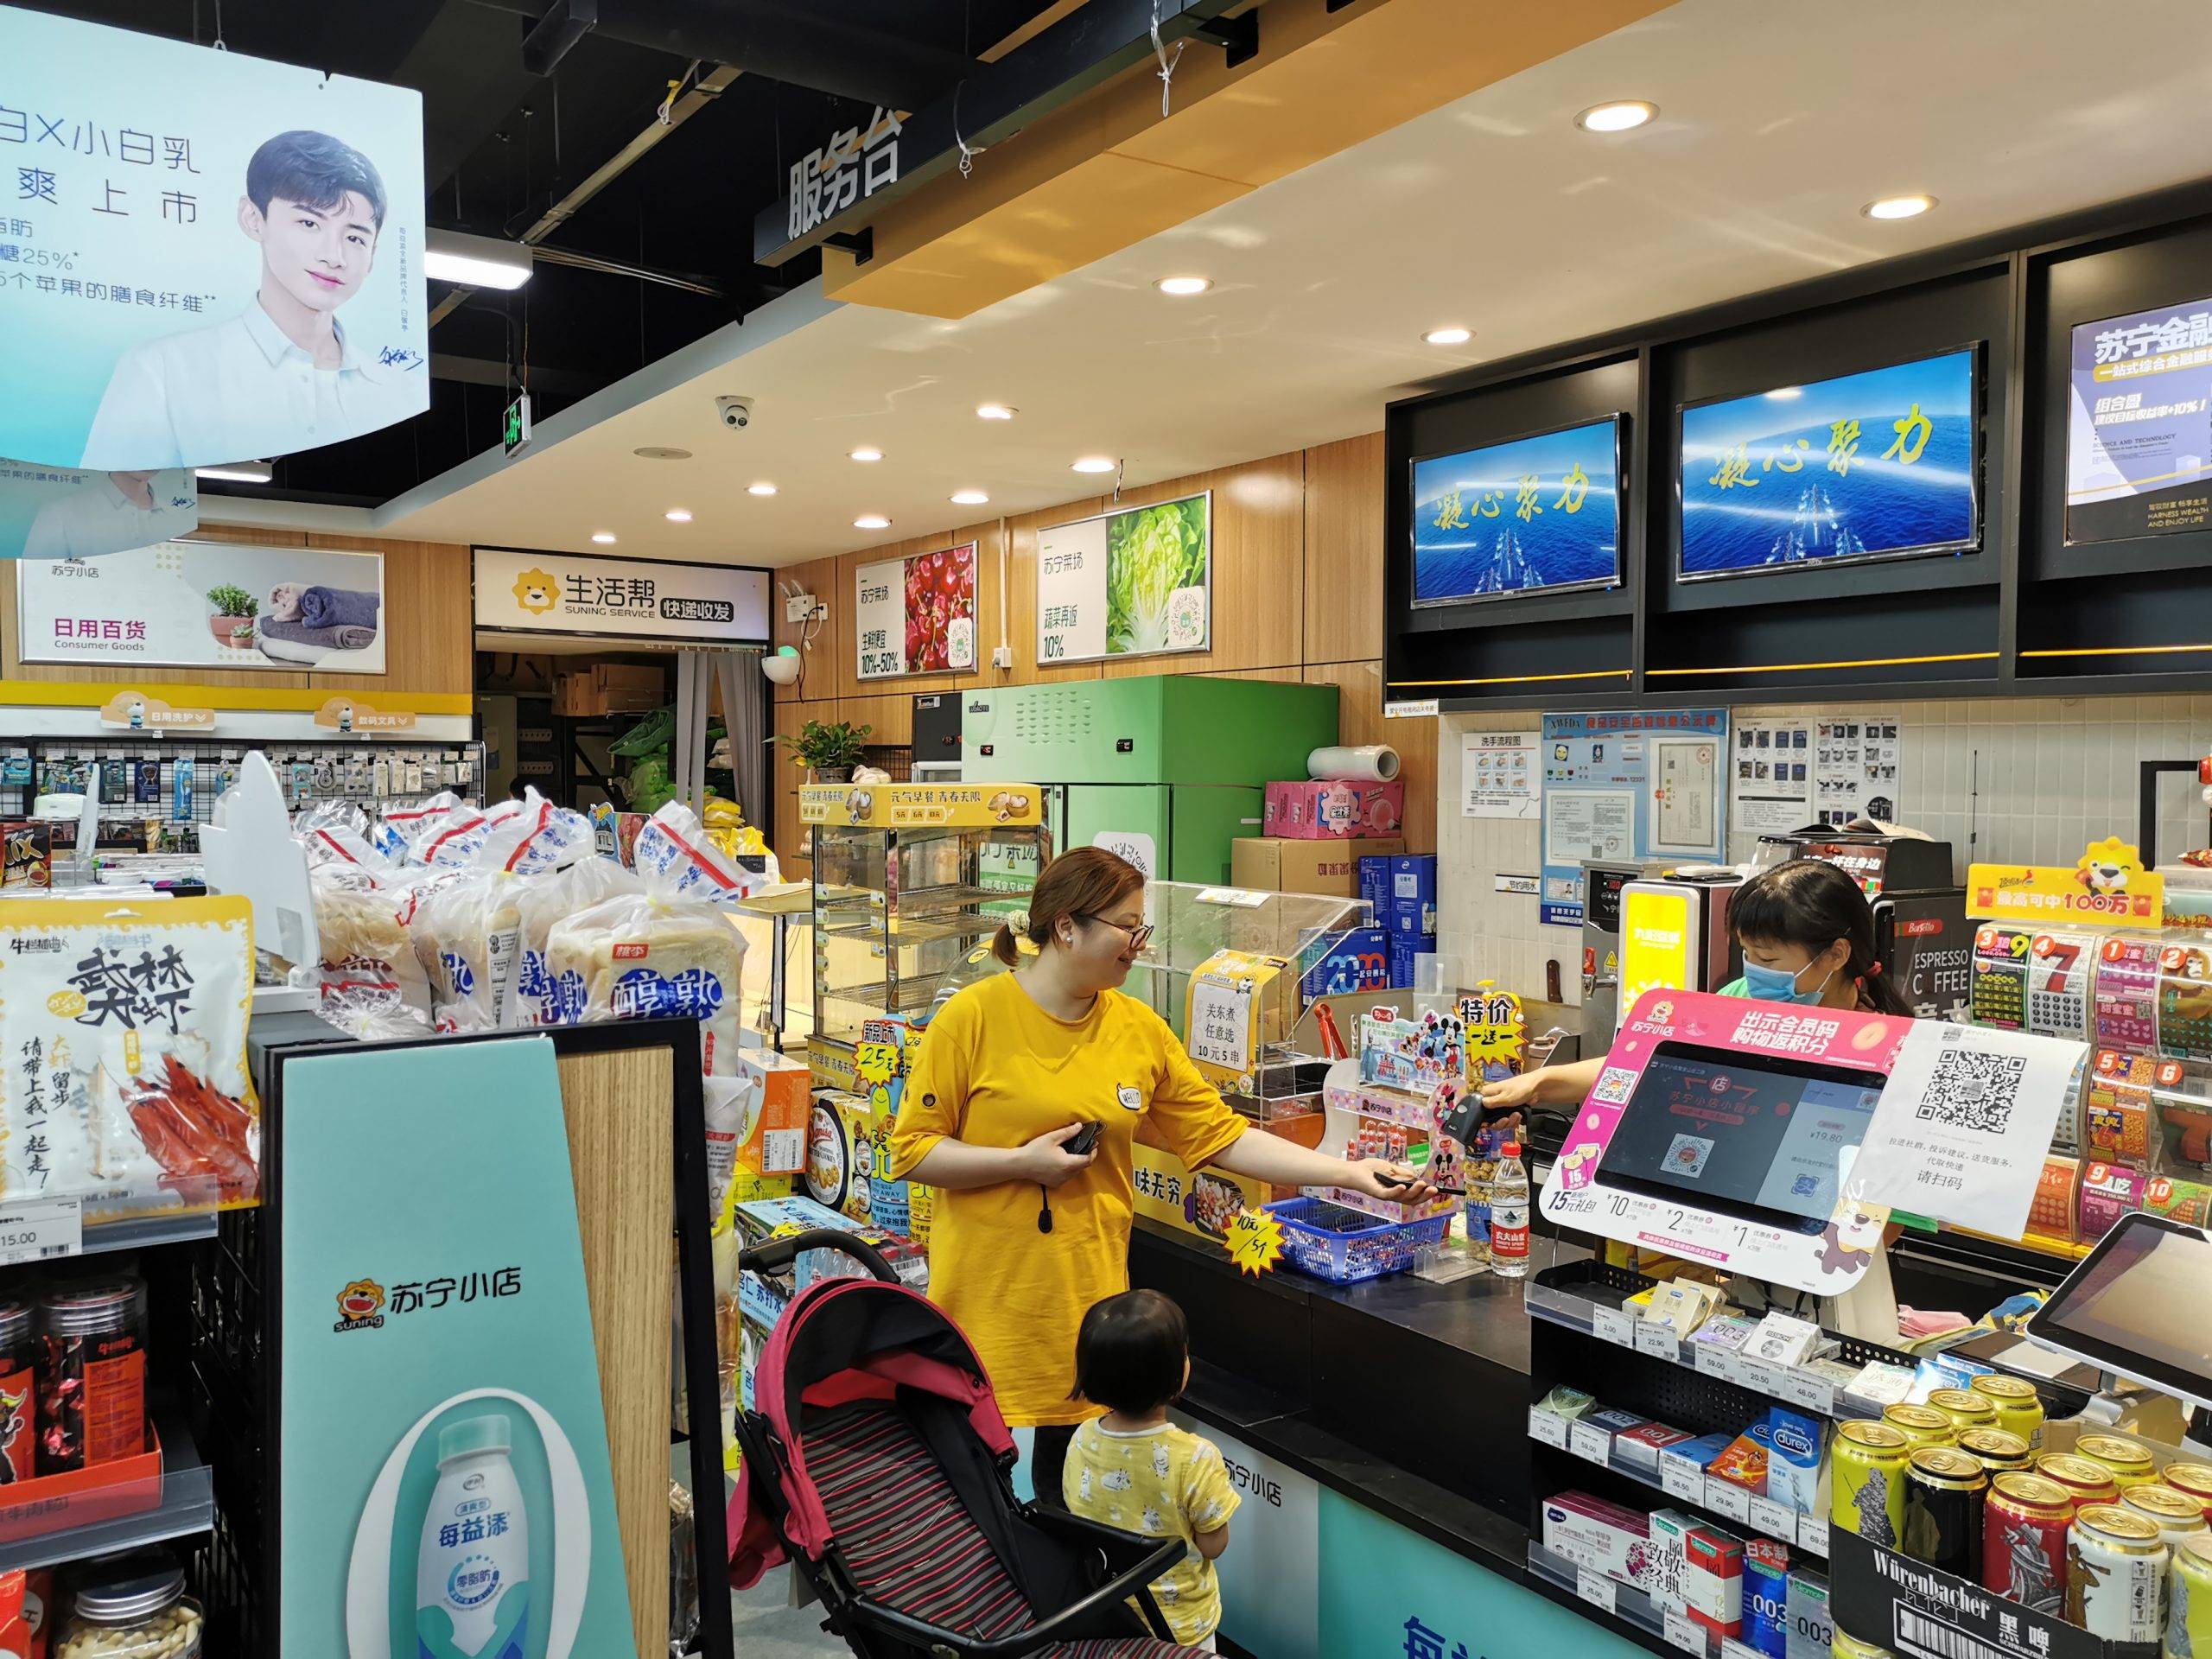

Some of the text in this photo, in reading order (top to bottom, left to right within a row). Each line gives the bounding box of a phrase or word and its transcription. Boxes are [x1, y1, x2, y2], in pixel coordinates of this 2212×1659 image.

[788, 105, 903, 240] 服务台
[1709, 403, 1933, 490] 凝心聚力
[1433, 462, 1590, 531] 凝心聚力
[52, 565, 99, 578] 苏宁小店
[1044, 552, 1084, 575] 苏宁菜场
[565, 575, 655, 608] 生活帮
[861, 586, 889, 605] 苏宁菜场
[565, 606, 655, 619] SUNING SERVICE
[663, 600, 732, 621] 快递收发
[54, 618, 146, 640] 日用百货
[54, 640, 144, 652] Consumer Goods
[1044, 634, 1064, 658] 10%
[862, 652, 898, 675] 10%-50%
[1481, 736, 1521, 747] 洗手流程图
[891, 791, 982, 803] 元气早餐 青春无限
[1510, 880, 1537, 891] 节约用水
[1914, 950, 1968, 969] ESPRESSO
[1206, 1003, 1236, 1022] 关东煮
[1460, 997, 1512, 1026] 特价
[1205, 1024, 1235, 1043] 任意选
[1630, 1021, 1675, 1037] 苏宁小店
[1742, 1011, 1840, 1039] 出示会员码
[1465, 1027, 1513, 1046] 一送一
[1730, 1026, 1831, 1056] 购物返积分
[1712, 1077, 1728, 1091] 店
[1927, 1156, 1964, 1172] 代取快递
[1135, 1166, 1181, 1207] 味无穷
[1916, 1169, 1963, 1191] 请扫码
[391, 1267, 521, 1314] 苏宁小店
[757, 1284, 783, 1314] 苏打水
[334, 1314, 384, 1332] suning
[1713, 1324, 1746, 1340] 003
[1750, 1373, 1770, 1383] 20.50
[1777, 1433, 1810, 1452] durex
[439, 1512, 509, 1548] 每益添
[457, 1569, 491, 1588] 零脂肪
[1873, 1549, 1990, 1621] Würenbacher
[1753, 1594, 1787, 1623] 003
[1797, 1617, 1832, 1646] 003
[1999, 1611, 2050, 1656] 黑啤
